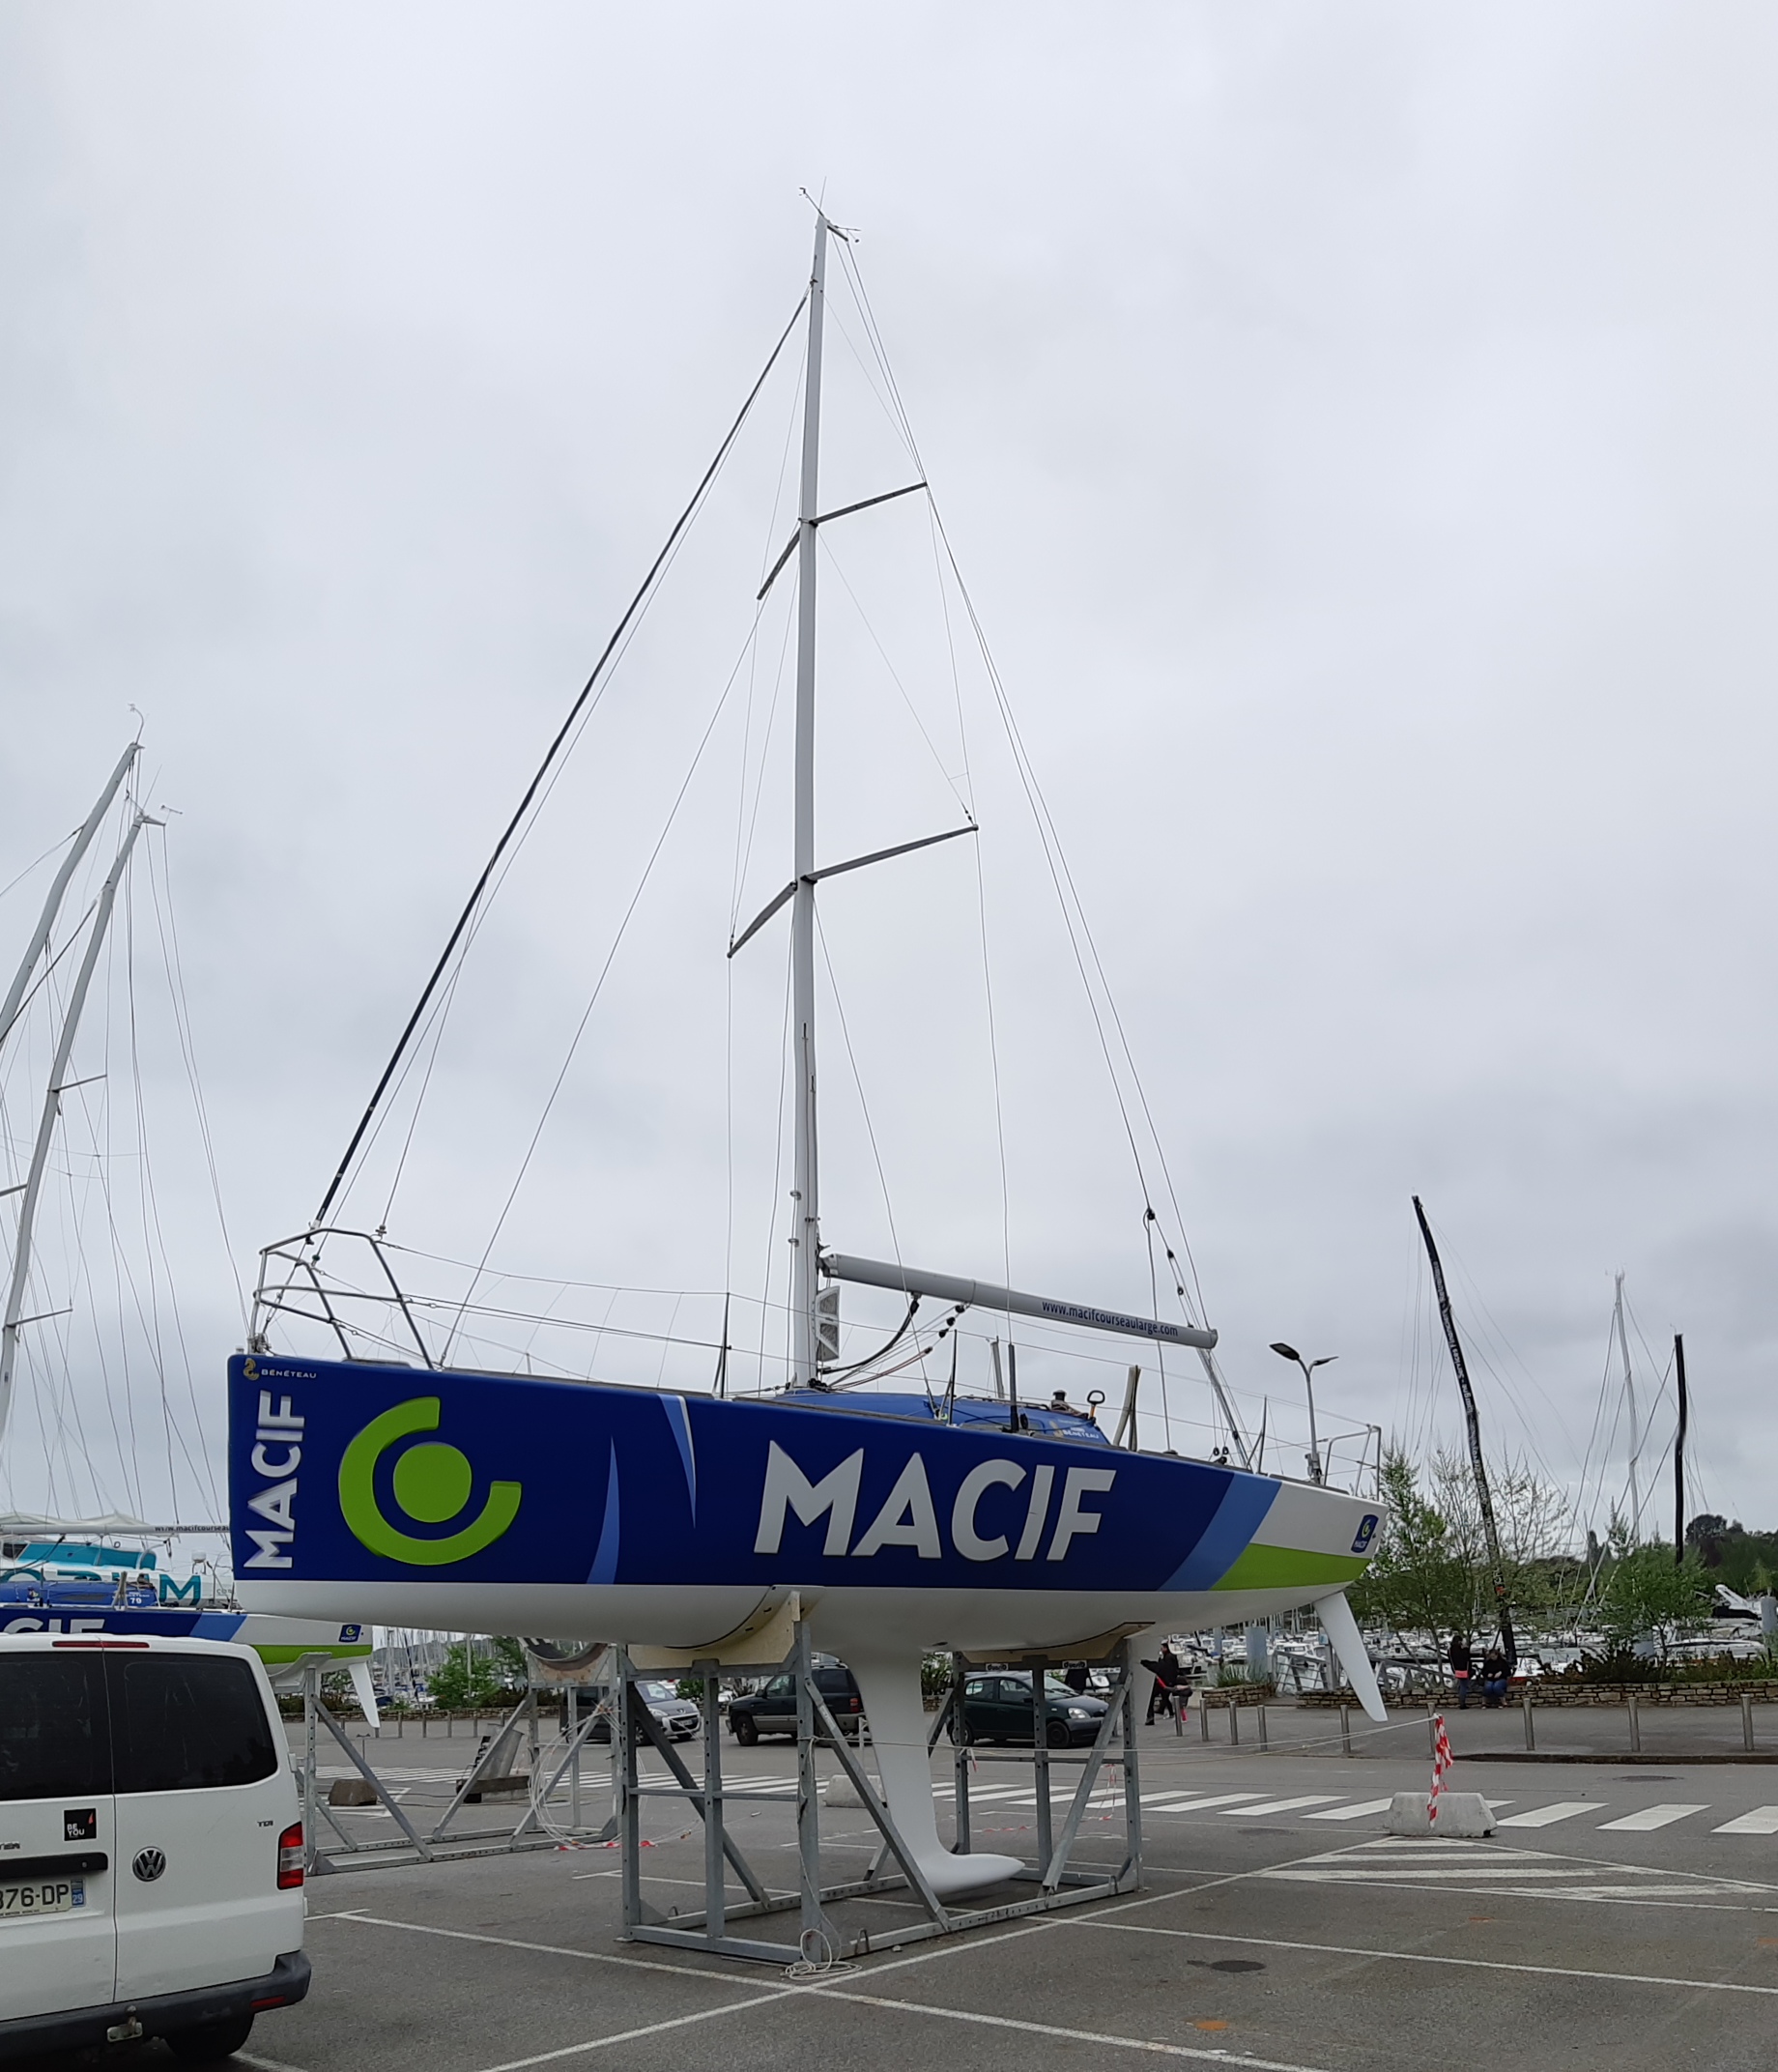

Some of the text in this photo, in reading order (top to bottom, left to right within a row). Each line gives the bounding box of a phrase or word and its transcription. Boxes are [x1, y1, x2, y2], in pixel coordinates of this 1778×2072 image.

[1042, 1301, 1179, 1337] www.macifcourseaularge.com
[243, 1389, 305, 1568] MACIF
[754, 1439, 1117, 1562] MACIF
[68, 1827, 85, 1836] YOU
[72, 1893, 83, 1904] 29
